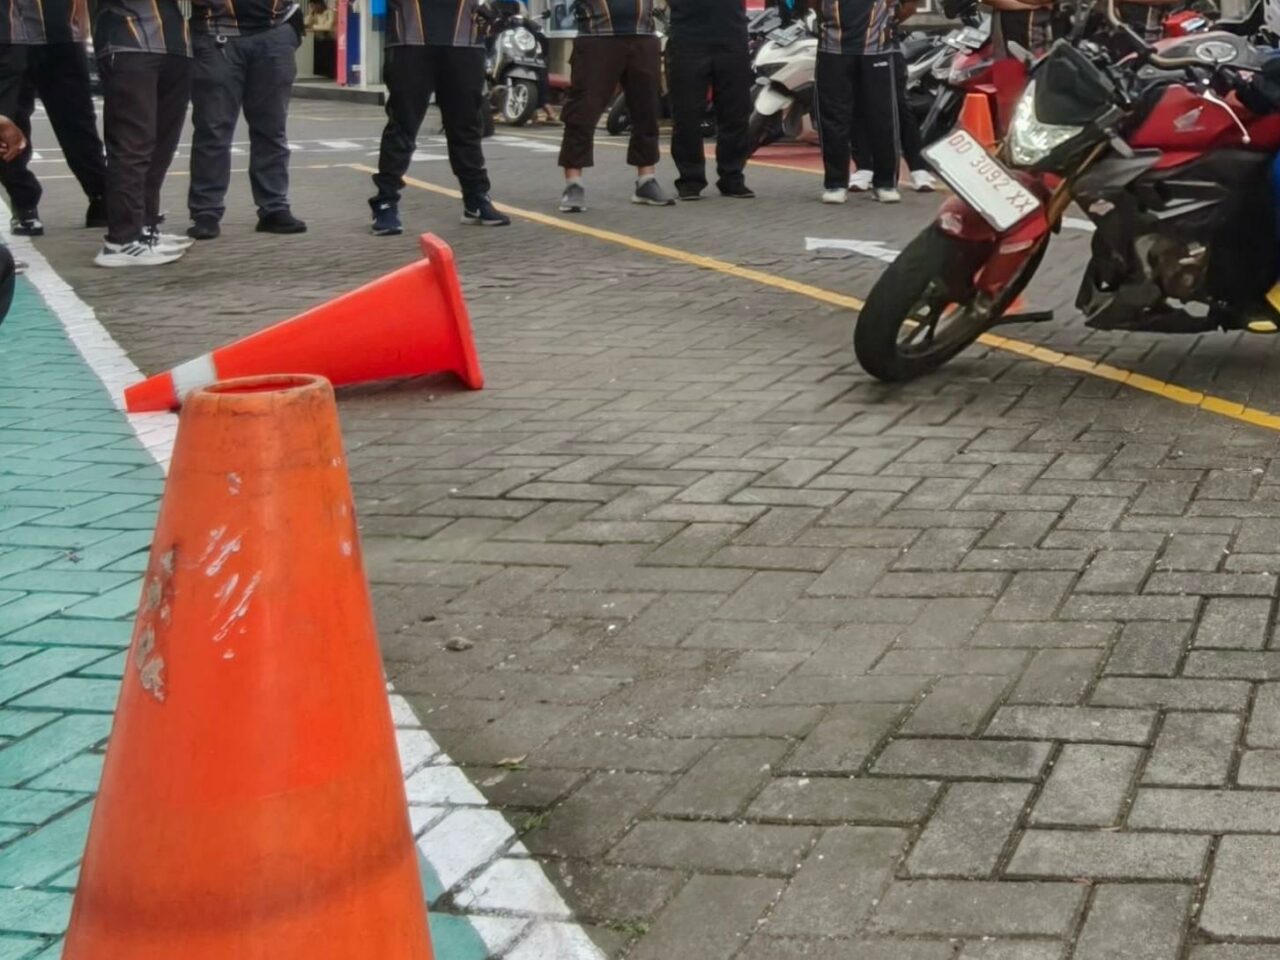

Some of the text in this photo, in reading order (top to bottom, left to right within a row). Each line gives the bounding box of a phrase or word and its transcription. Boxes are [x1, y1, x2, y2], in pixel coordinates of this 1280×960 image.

[948, 134, 1034, 213] DD 3092 XX
